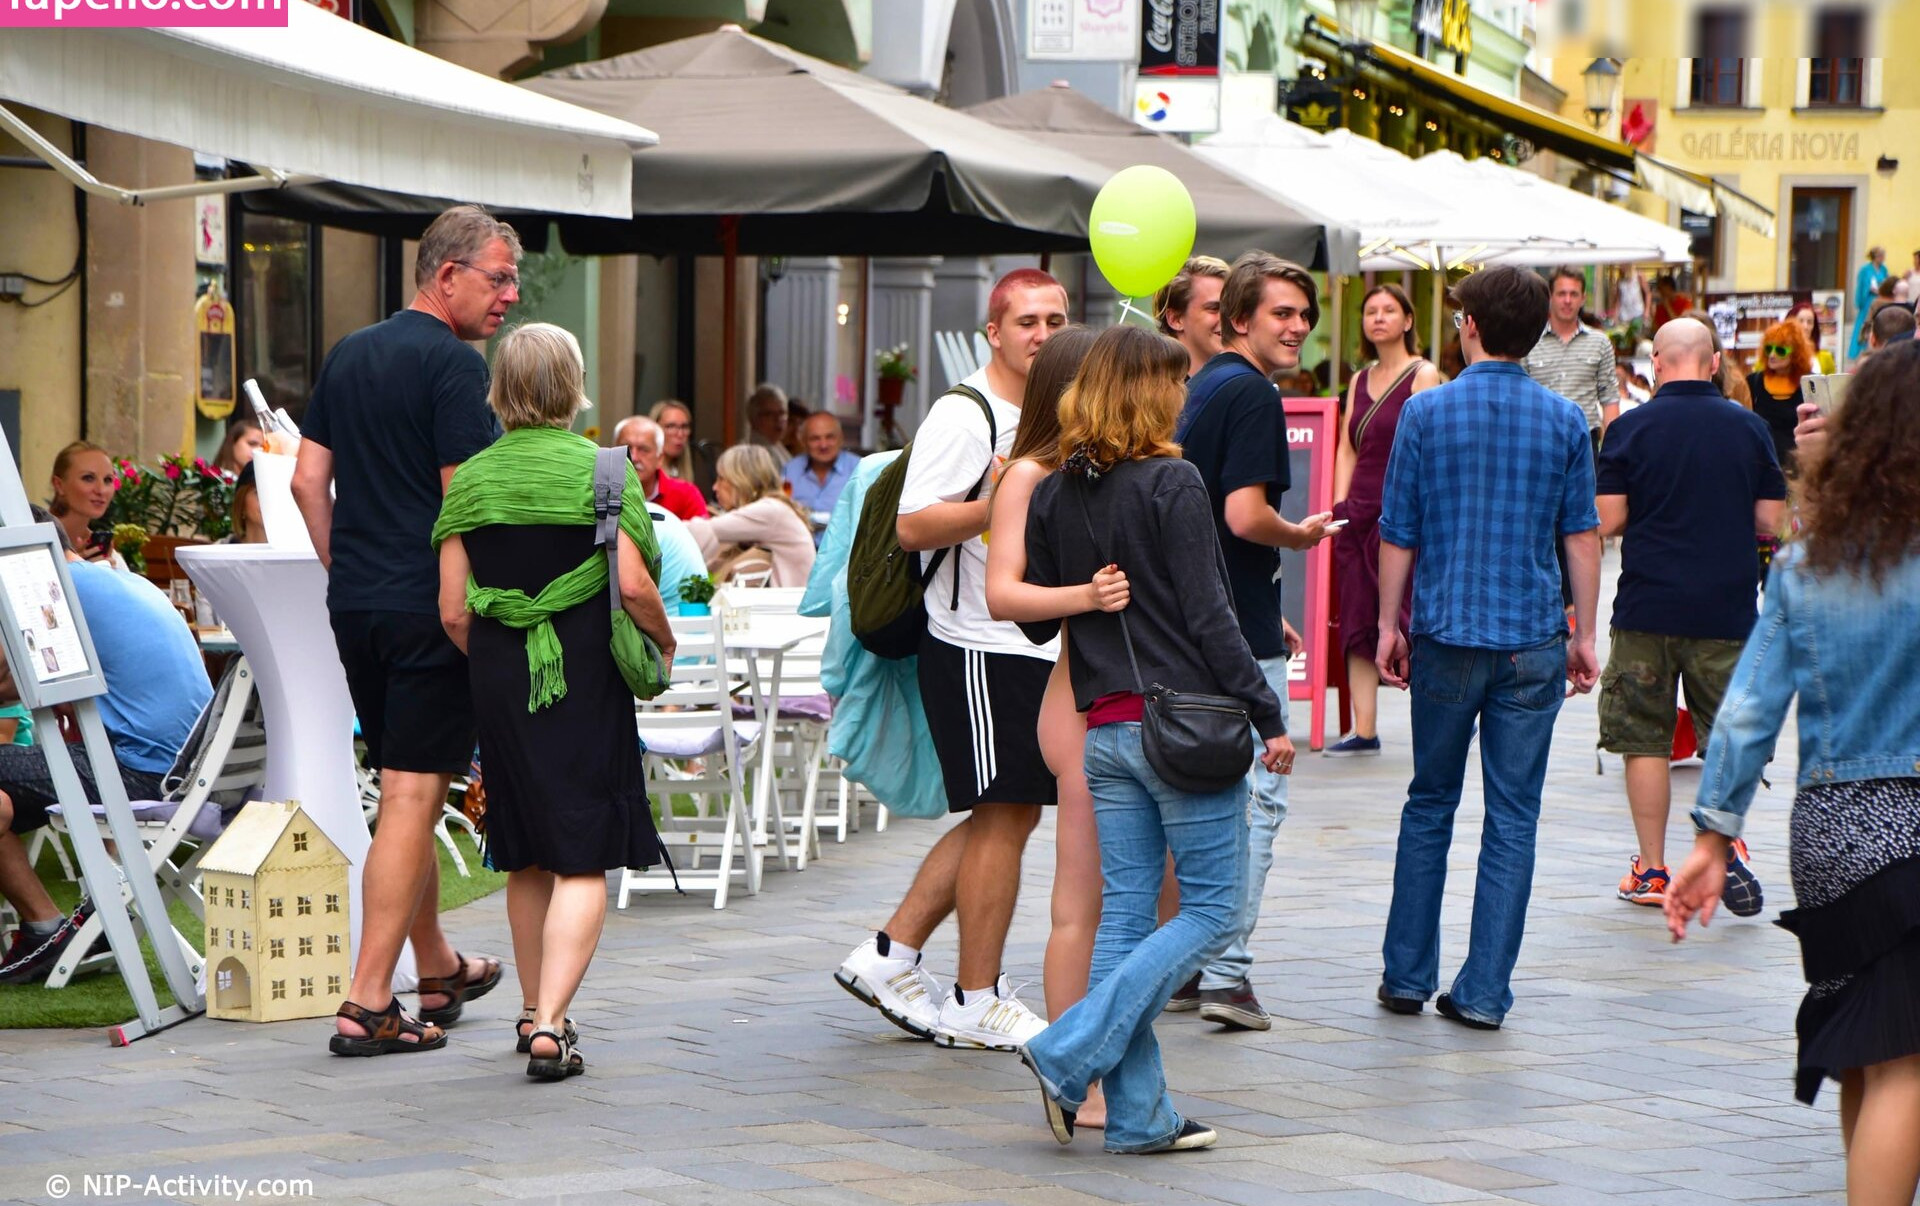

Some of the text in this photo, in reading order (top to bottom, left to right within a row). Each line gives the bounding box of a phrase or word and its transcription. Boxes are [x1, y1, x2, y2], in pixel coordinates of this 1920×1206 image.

[1176, 0, 1198, 67] STRO
[1680, 126, 1860, 161] GALÉRIA NOVA
